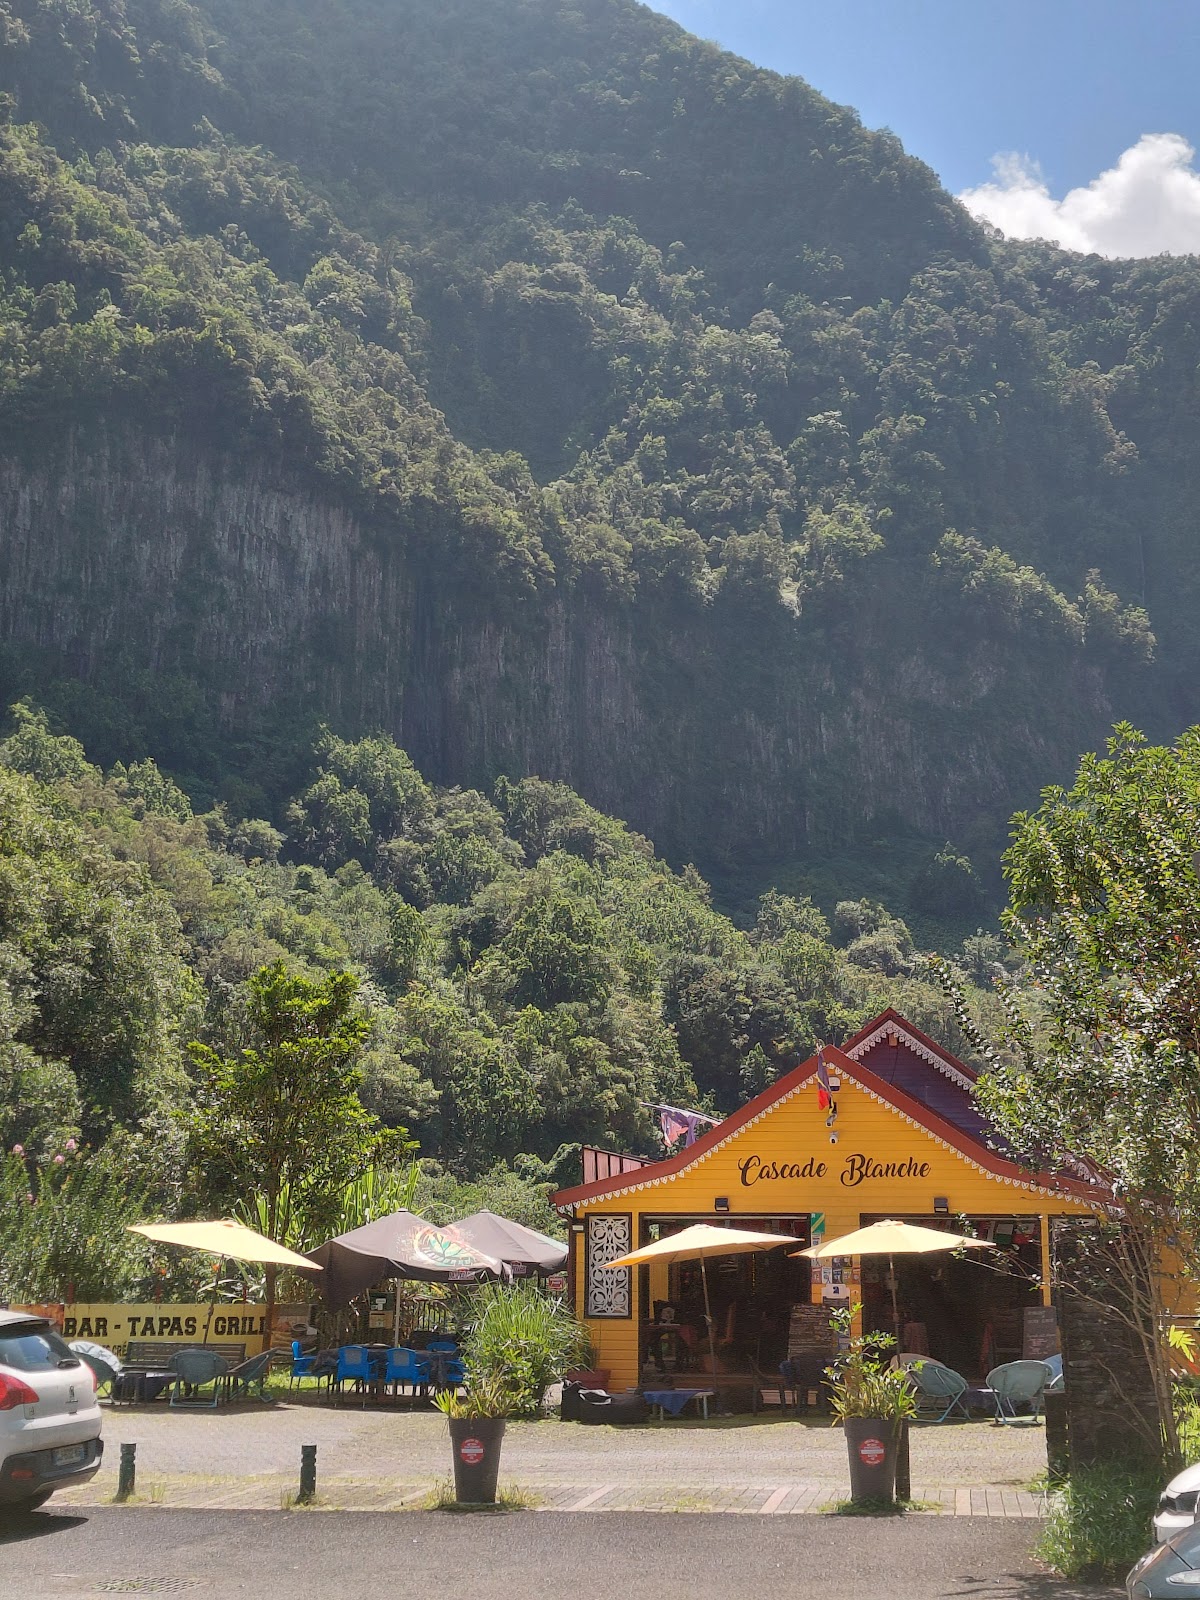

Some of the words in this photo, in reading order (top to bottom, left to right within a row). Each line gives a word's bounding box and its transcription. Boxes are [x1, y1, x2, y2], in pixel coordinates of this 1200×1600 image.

[738, 1155, 828, 1187] Cascade
[840, 1153, 931, 1187] Blanche
[63, 1317, 108, 1338] BAR
[127, 1316, 197, 1337] TAPAS
